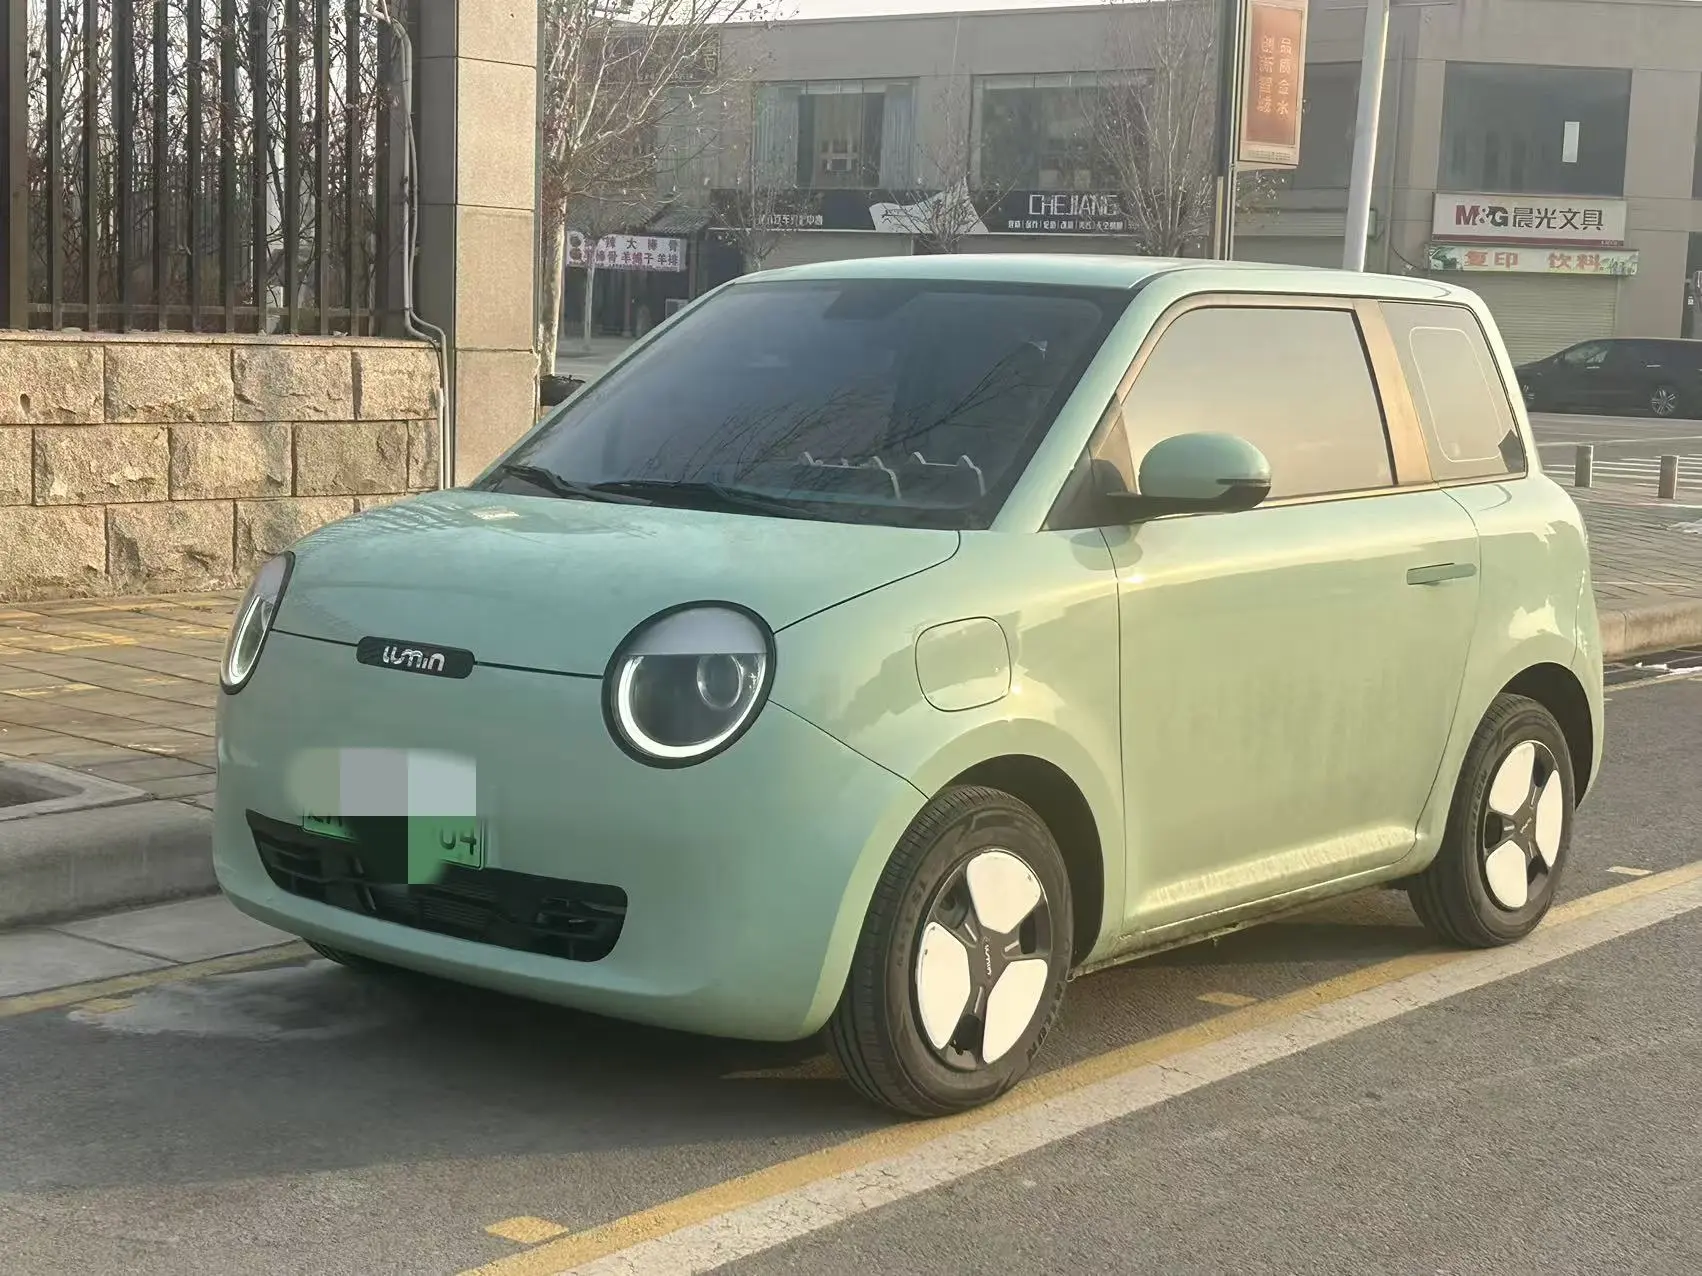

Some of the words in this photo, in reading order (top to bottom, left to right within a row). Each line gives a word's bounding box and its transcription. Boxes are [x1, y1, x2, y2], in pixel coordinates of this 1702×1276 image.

[1512, 207, 1604, 231] 晨光文具
[1464, 250, 1519, 269] 复印
[1548, 252, 1601, 271] 饮料
